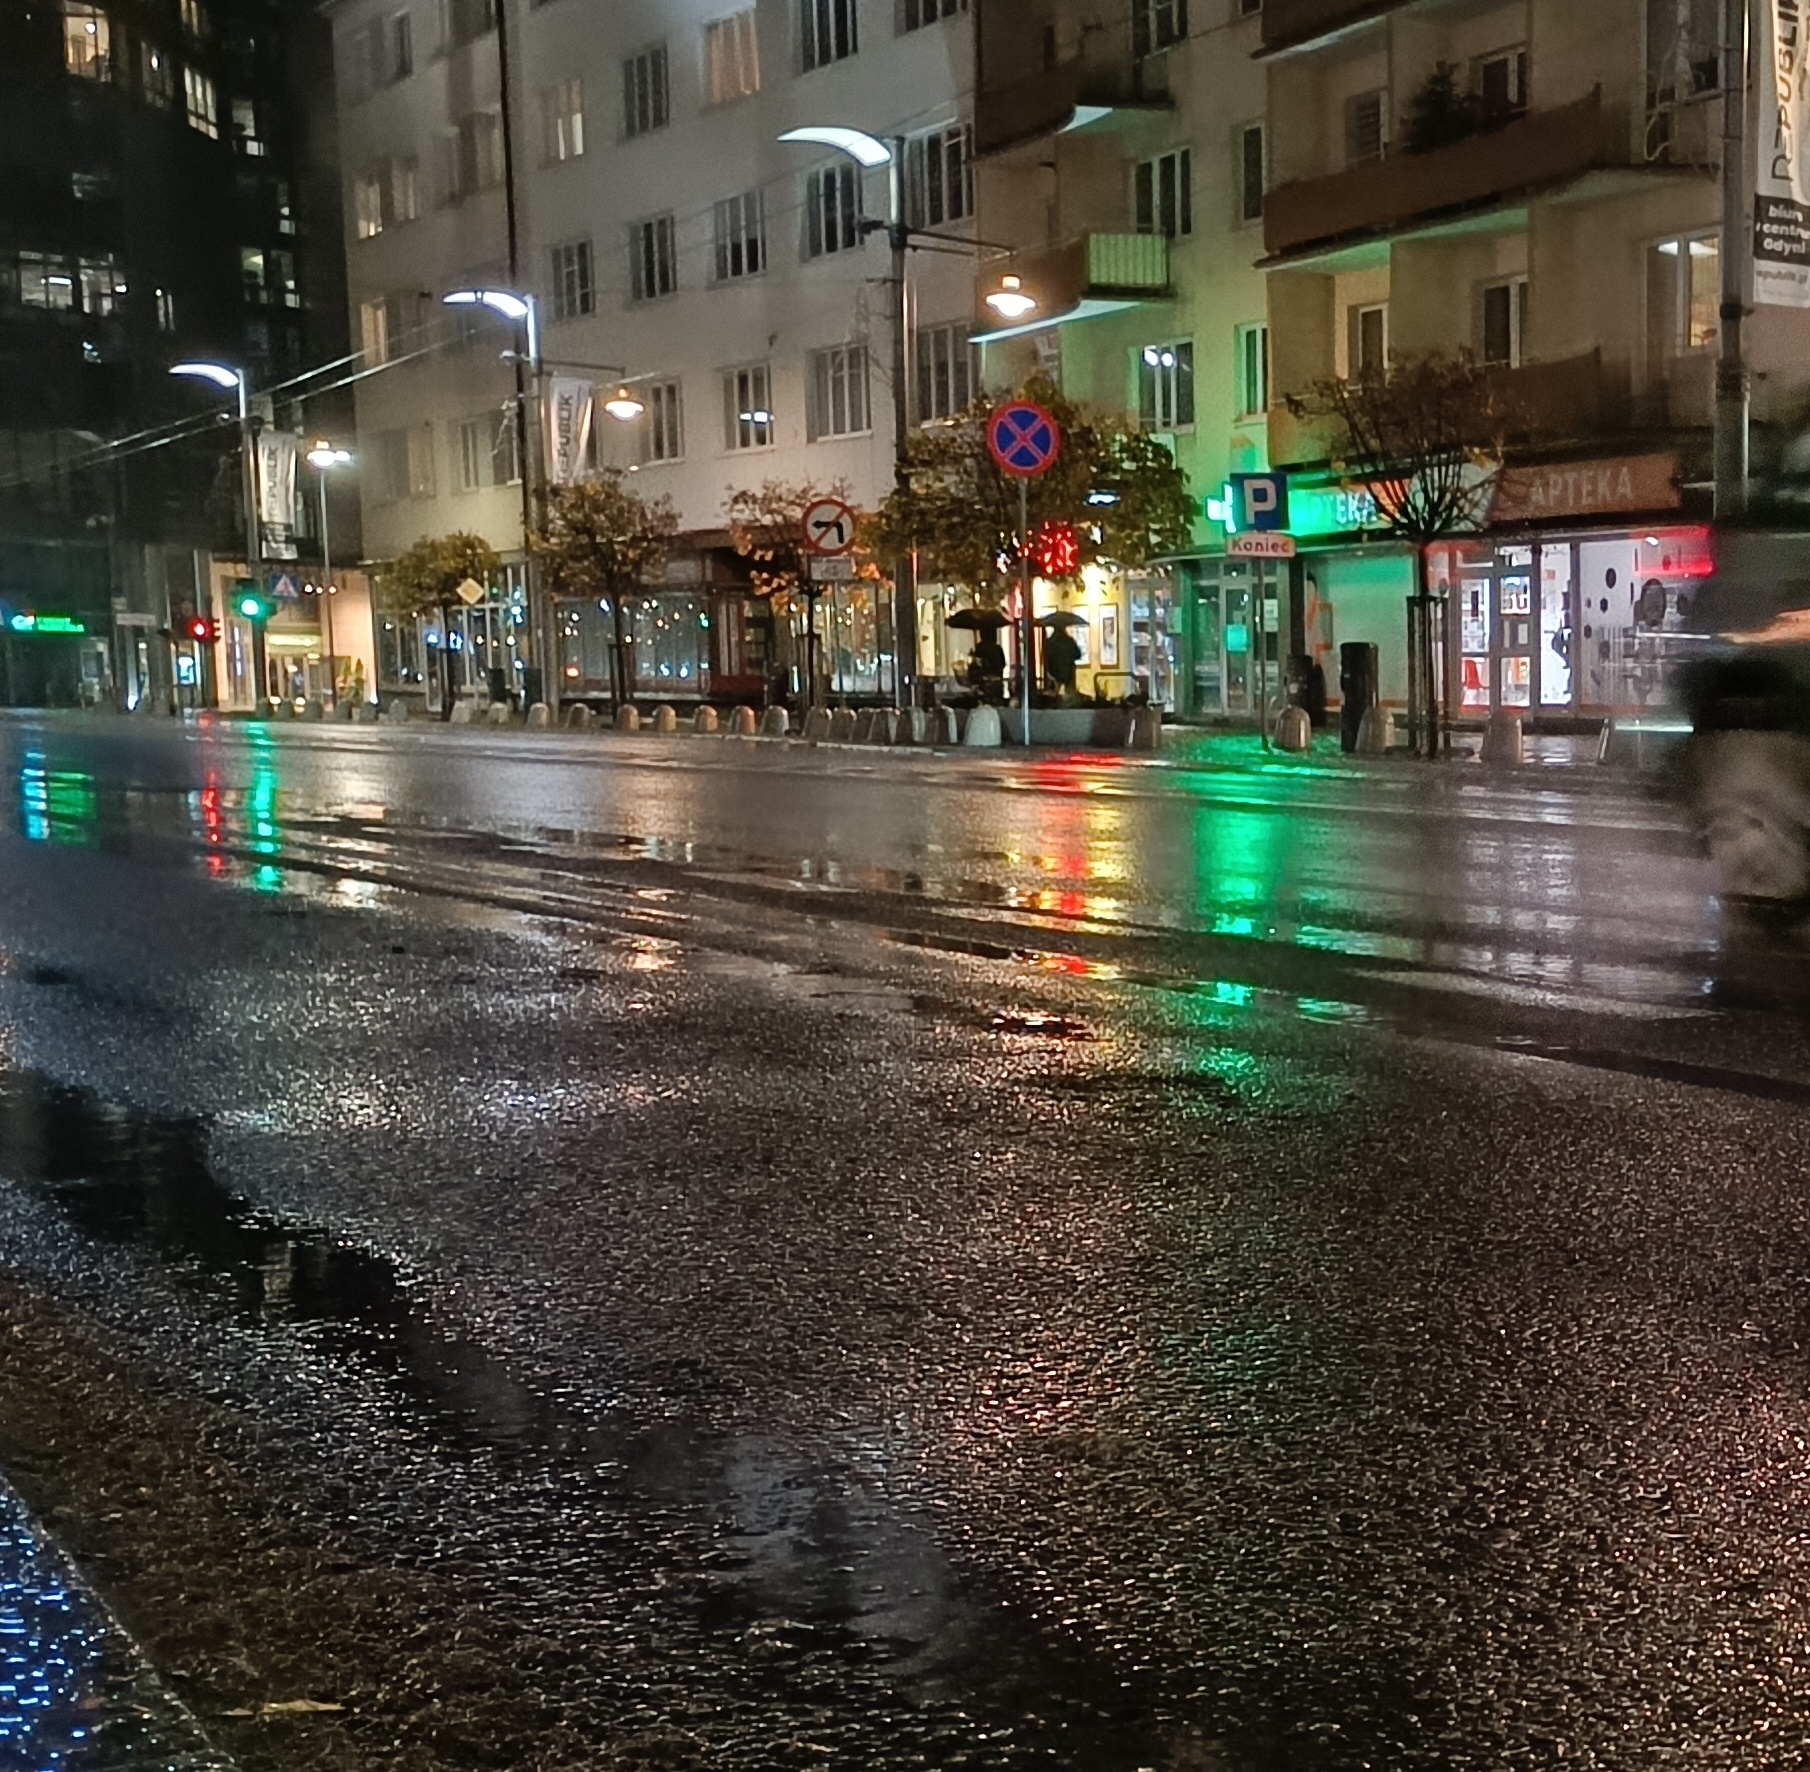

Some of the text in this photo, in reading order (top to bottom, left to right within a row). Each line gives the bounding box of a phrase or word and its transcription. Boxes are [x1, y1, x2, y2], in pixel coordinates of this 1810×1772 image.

[1244, 478, 1277, 525] P
[1527, 466, 1636, 506] APTEKA
[1231, 537, 1290, 554] Koniec
